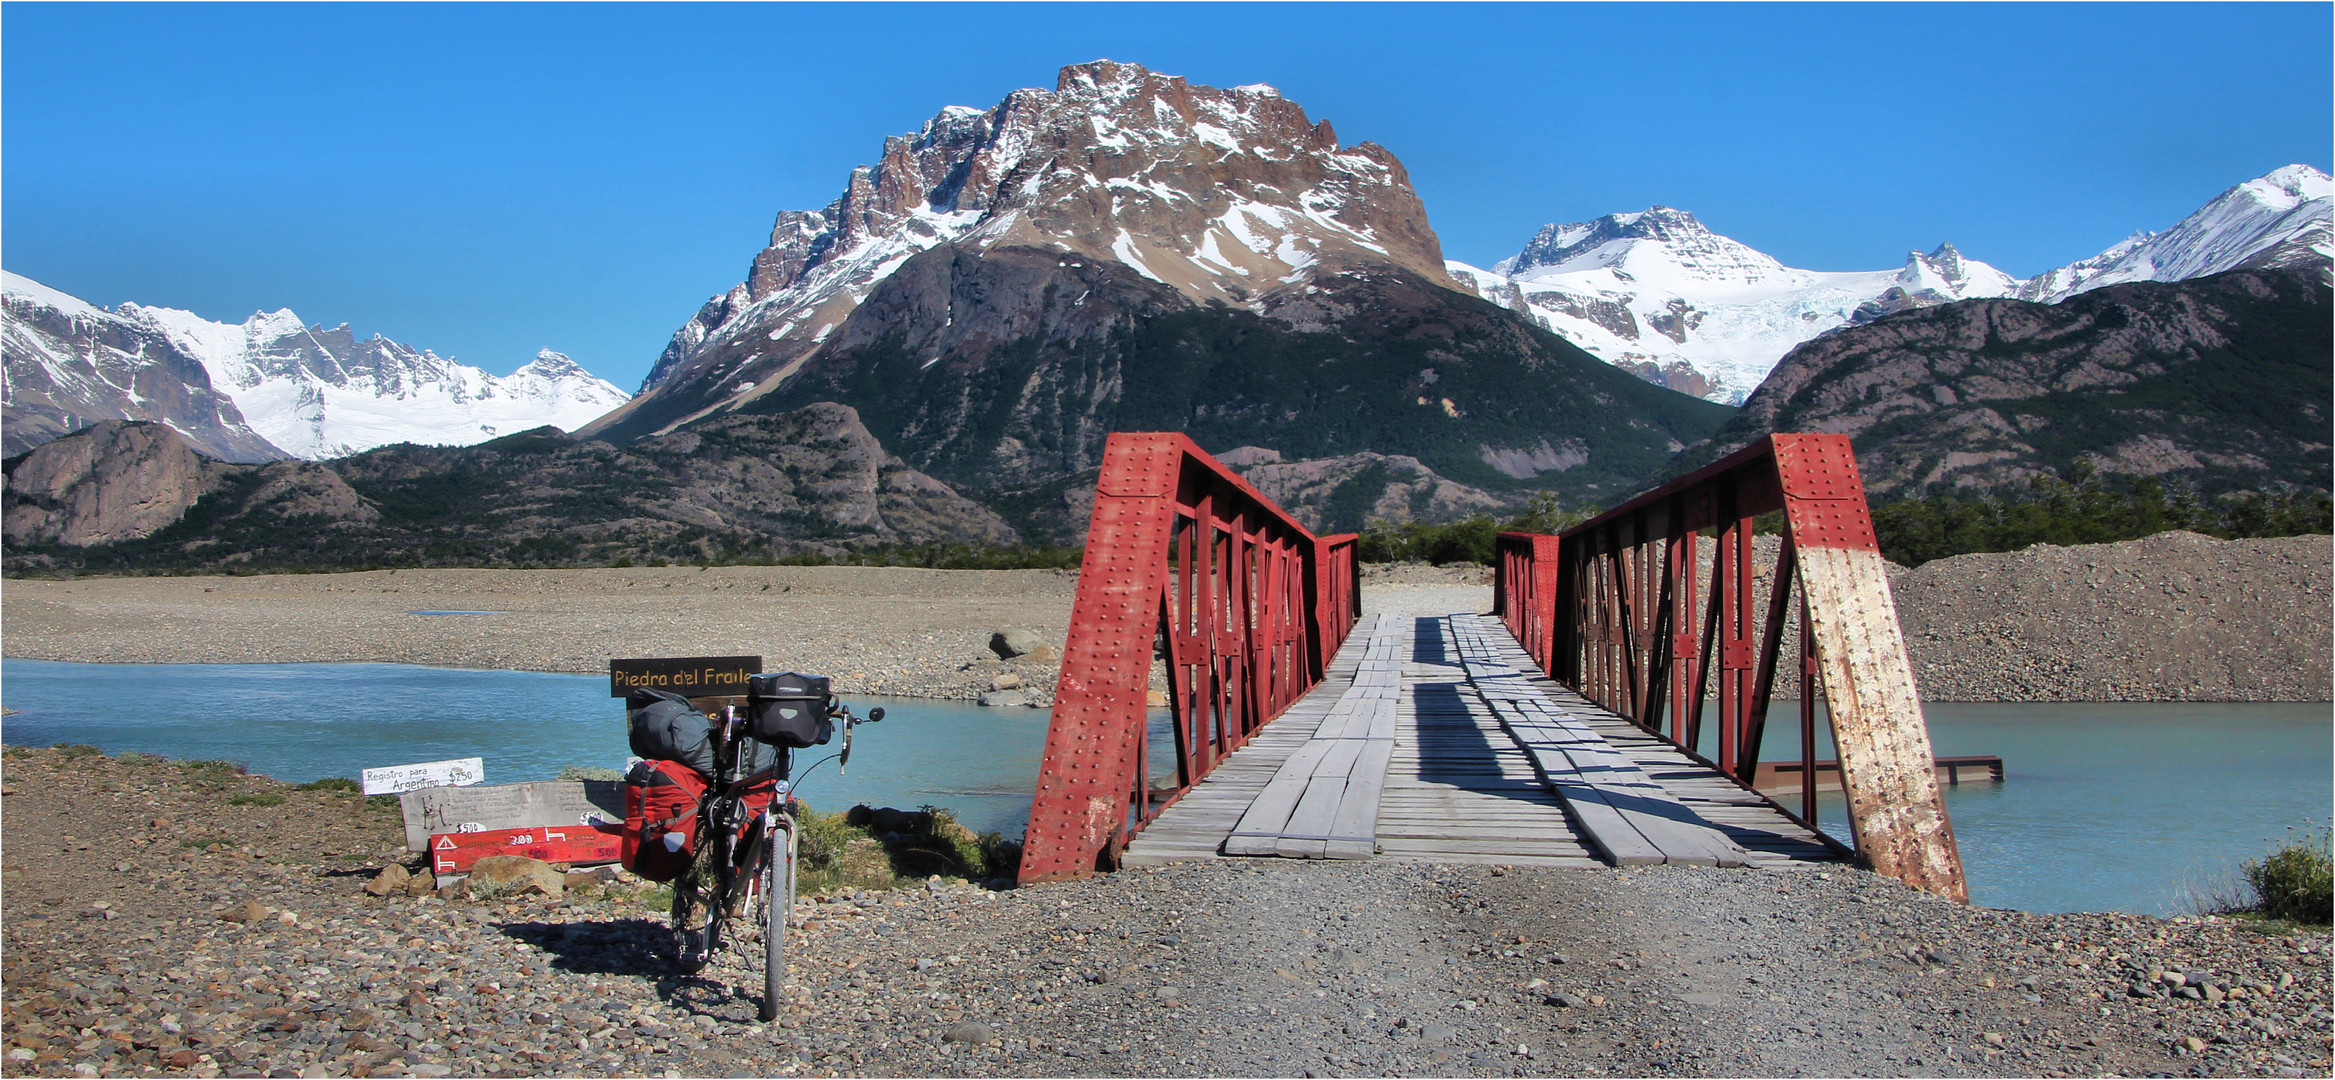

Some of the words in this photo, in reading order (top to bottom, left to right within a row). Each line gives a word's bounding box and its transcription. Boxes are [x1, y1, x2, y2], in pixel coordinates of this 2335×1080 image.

[614, 669, 669, 687] Piedra
[673, 667, 699, 685] del
[704, 667, 752, 685] Fraile
[367, 770, 405, 783] Registro
[409, 768, 428, 779] para
[448, 770, 473, 785] $250
